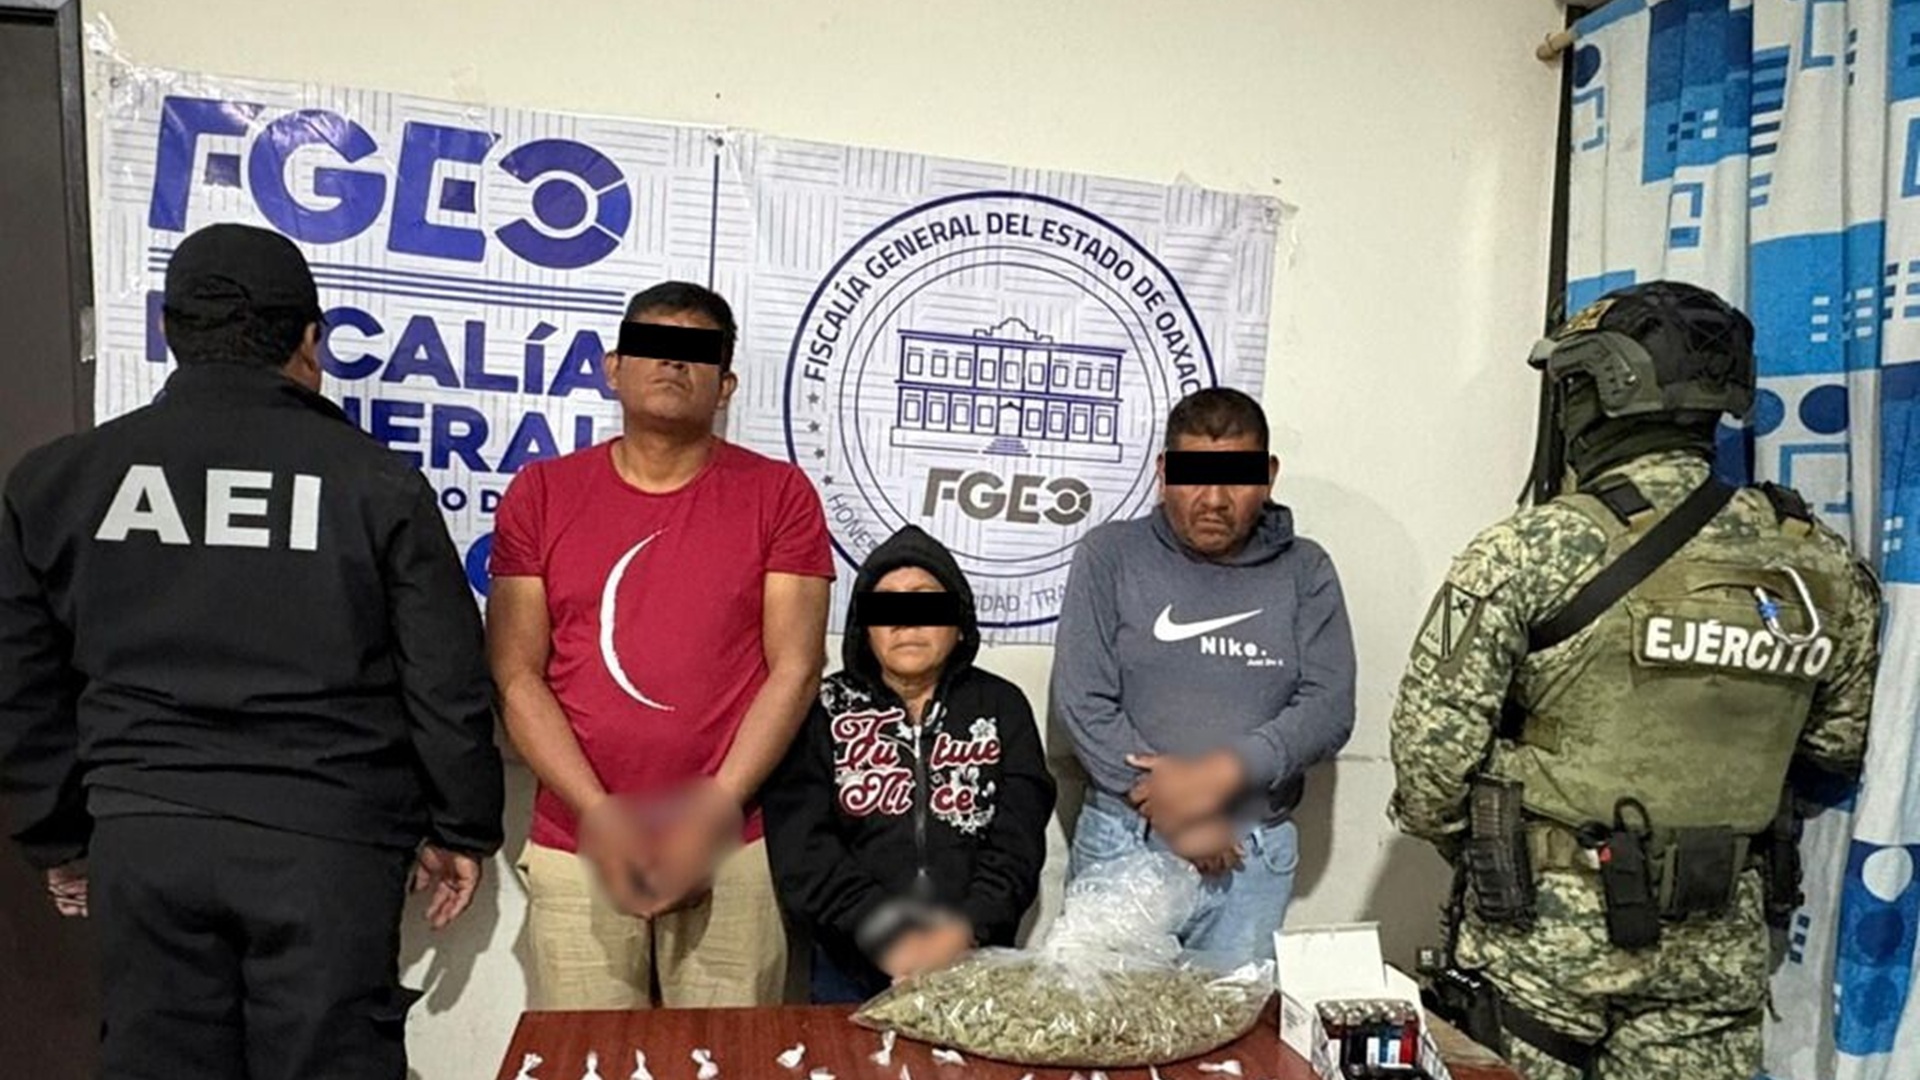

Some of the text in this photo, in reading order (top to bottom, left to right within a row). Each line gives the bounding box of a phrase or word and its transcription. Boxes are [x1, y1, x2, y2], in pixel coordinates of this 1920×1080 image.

[148, 95, 632, 269] FGEO
[803, 212, 1202, 398] FISCALÍA GENERAL DEL ESTADO DE OAXAC
[94, 464, 322, 552] AEI
[922, 467, 1093, 526] FGEO
[1645, 617, 1833, 676] EJÉRCITO
